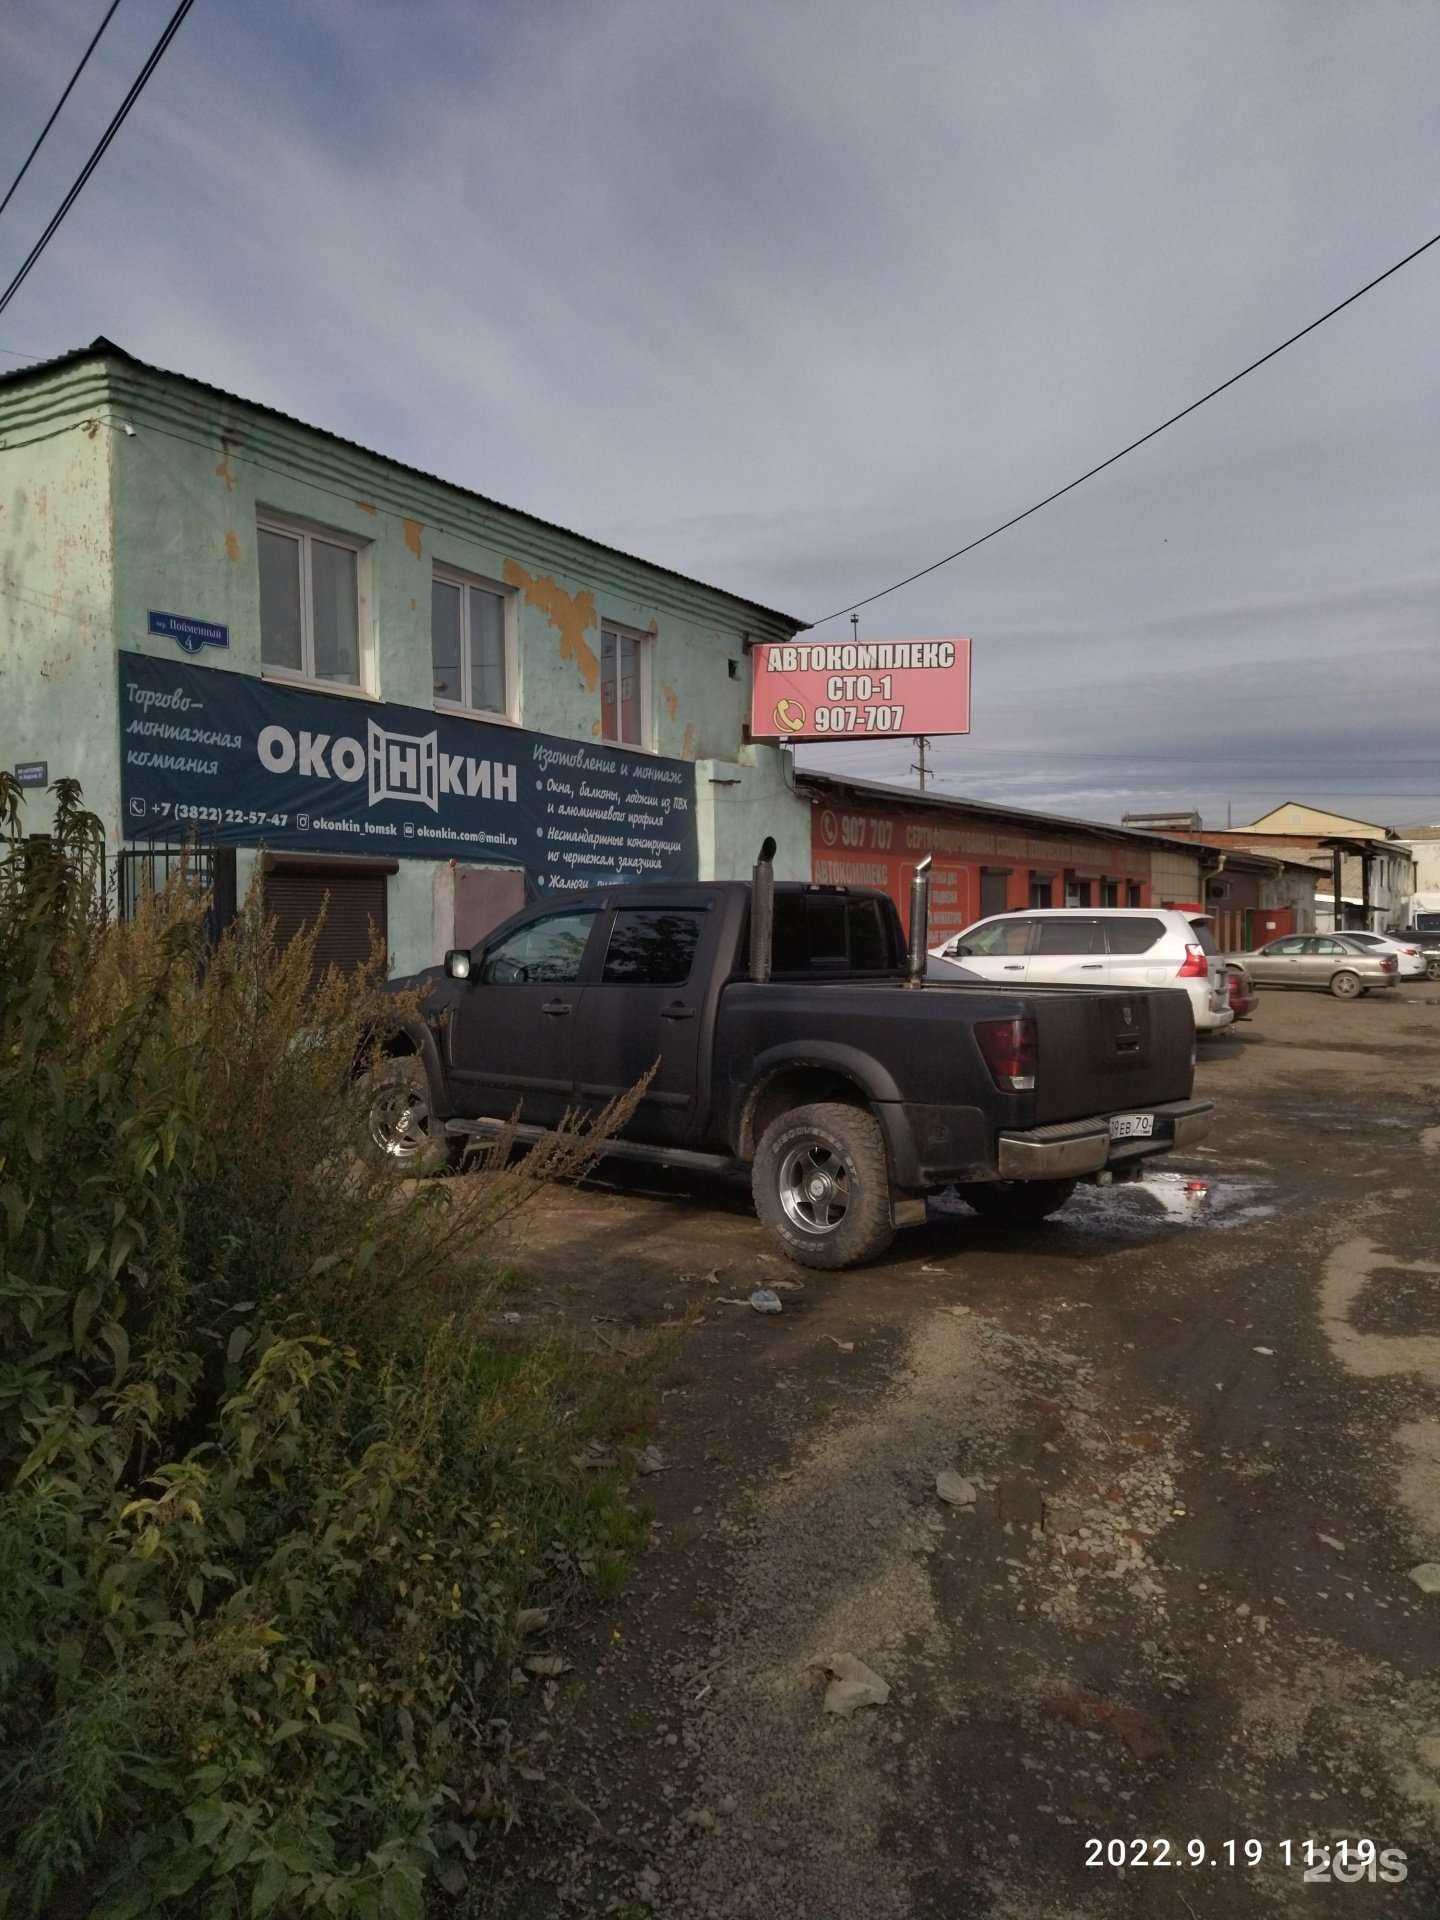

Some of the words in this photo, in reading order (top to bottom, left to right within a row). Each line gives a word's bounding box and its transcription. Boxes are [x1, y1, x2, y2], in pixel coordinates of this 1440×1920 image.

[169, 618, 222, 640] Пойменный
[184, 635, 193, 650] 4
[767, 642, 955, 672] АВТОКОМПЛЕКС
[827, 675, 892, 701] СТО-1
[814, 705, 904, 732] 907-707
[126, 719, 242, 750] монтажная
[127, 749, 219, 776] компания
[533, 743, 617, 773] Изготовление
[620, 763, 629, 776] и
[632, 765, 683, 785] монтаж
[546, 778, 574, 798] Окна,
[579, 781, 621, 805] балконы,
[625, 789, 658, 806] лоджии
[661, 799, 671, 815] из
[673, 796, 688, 812] ПВХ
[151, 802, 171, 817] +7
[174, 804, 222, 823] (3822)
[225, 809, 288, 828] 22-57-47
[312, 815, 398, 837] okonkin_tomsk
[547, 803, 555, 814] и
[557, 804, 626, 822] алюминиевого
[627, 813, 664, 830] профиля
[417, 826, 518, 846] okonkin.com@mail.ru
[547, 826, 625, 850] Нестандартные
[626, 838, 681, 857] конструкции
[841, 815, 867, 847] 907
[869, 820, 894, 849] 707
[548, 850, 559, 863] по
[562, 851, 615, 869] чертежам
[616, 855, 663, 875] заказчика
[1135, 1116, 1149, 1130] 70
